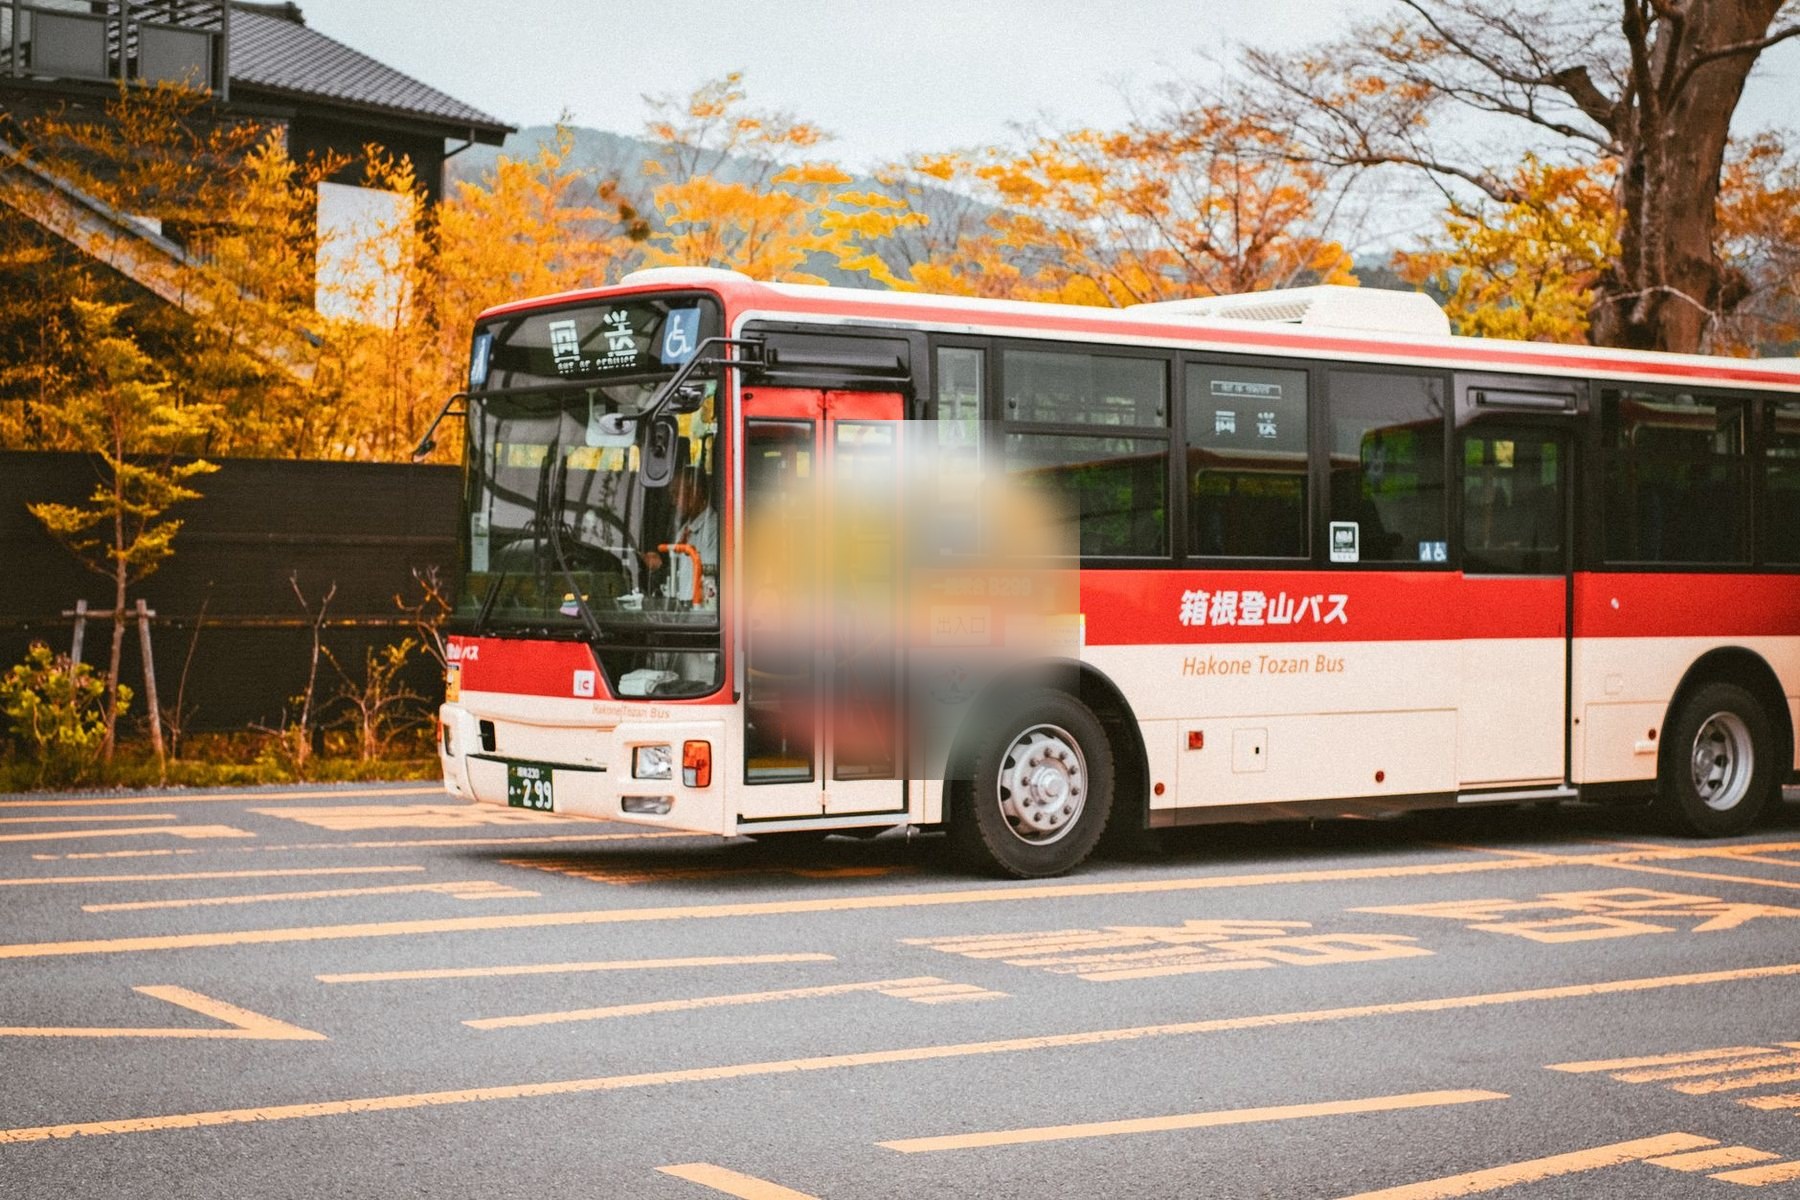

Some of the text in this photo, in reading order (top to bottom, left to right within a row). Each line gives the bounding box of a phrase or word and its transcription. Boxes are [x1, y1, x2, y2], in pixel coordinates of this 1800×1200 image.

[1179, 589, 1348, 626] 箱根登山バス
[1182, 654, 1345, 676] Hakone Tozan Bus
